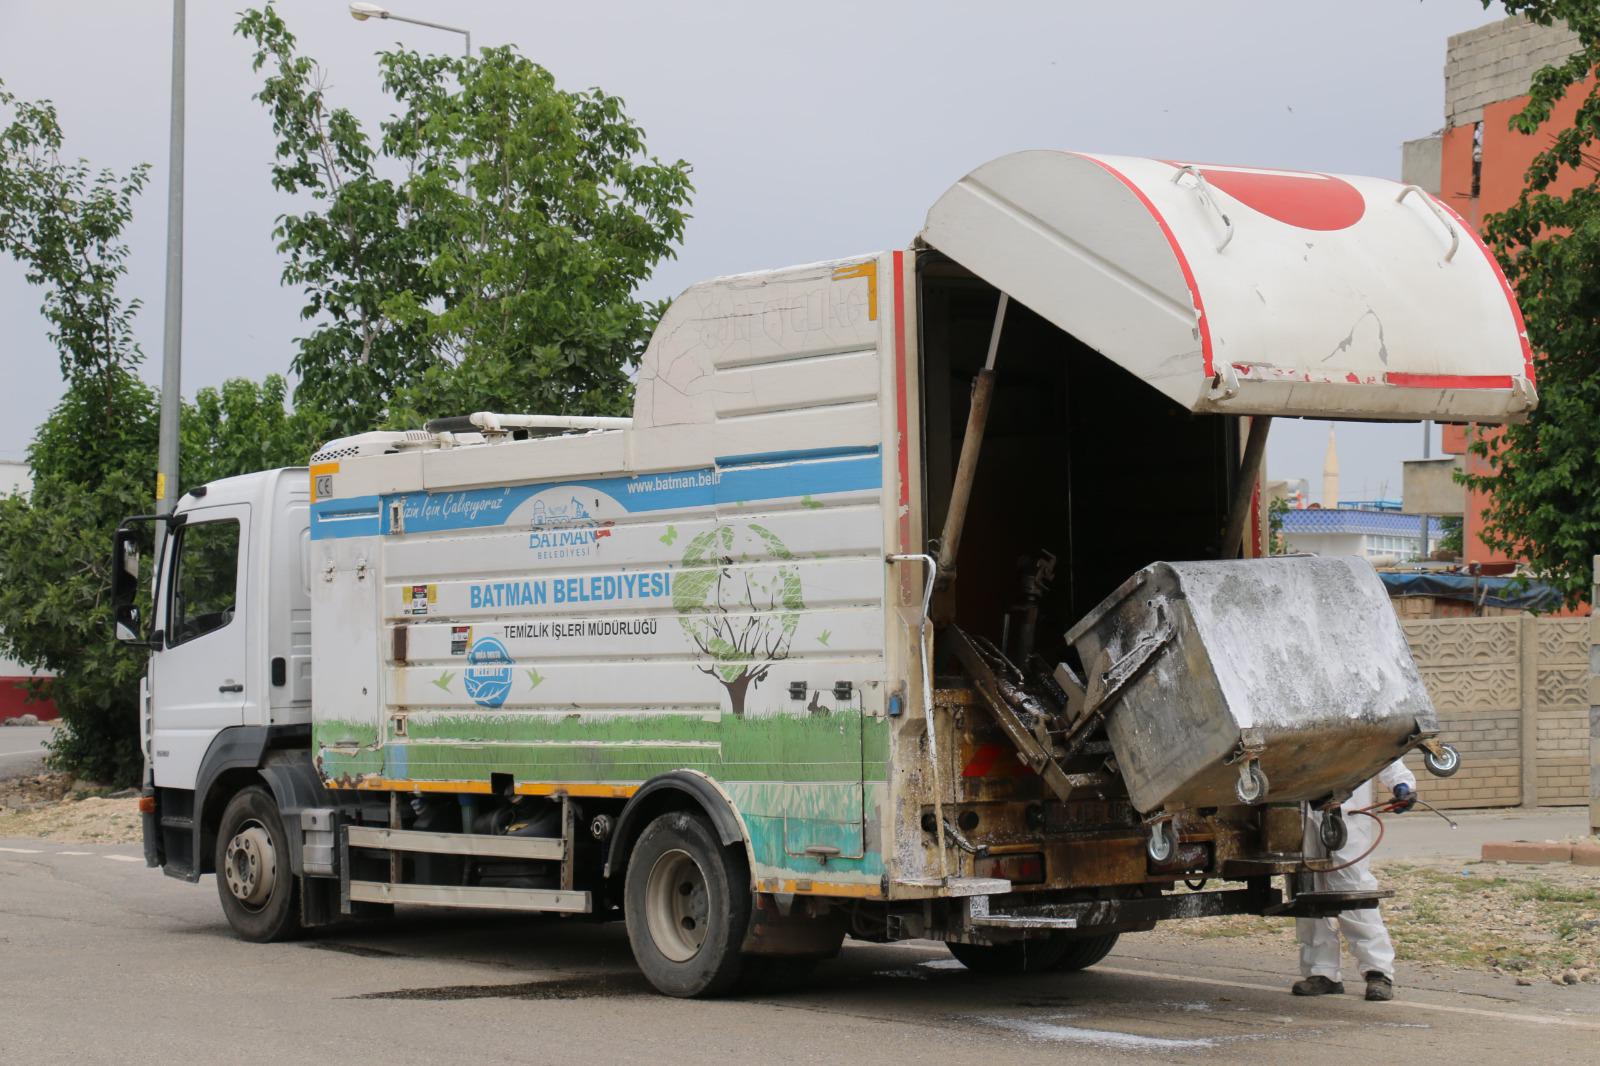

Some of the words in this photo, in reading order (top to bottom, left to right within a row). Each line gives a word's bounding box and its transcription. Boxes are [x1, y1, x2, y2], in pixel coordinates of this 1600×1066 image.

[402, 499, 419, 519] izin
[470, 580, 547, 608] BATMAN
[504, 622, 549, 639] TEMİZLİK
[552, 620, 585, 641] İŞLERİ
[588, 617, 658, 636] MÜDÜRLÜĞÜ
